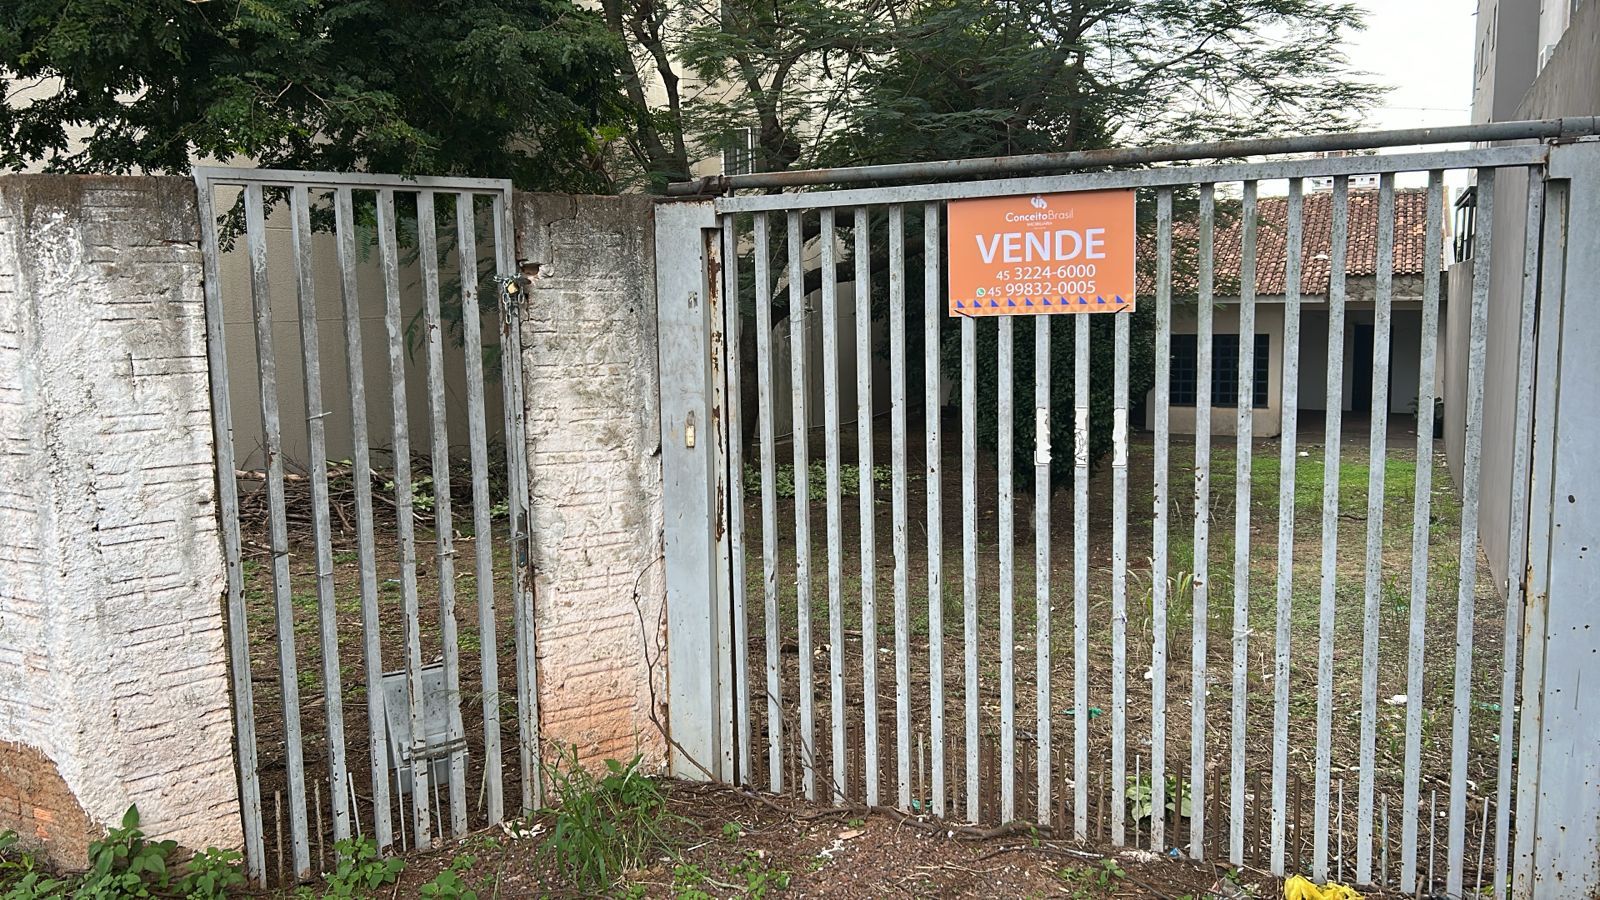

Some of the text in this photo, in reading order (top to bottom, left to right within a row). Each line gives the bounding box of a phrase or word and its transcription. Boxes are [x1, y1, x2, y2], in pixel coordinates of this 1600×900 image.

[1005, 208, 1074, 222] ConceitoBrasil
[975, 228, 1106, 264] VENDE
[996, 264, 1096, 281] 45 3224-6000
[988, 280, 1096, 297] 45 99832-0005
